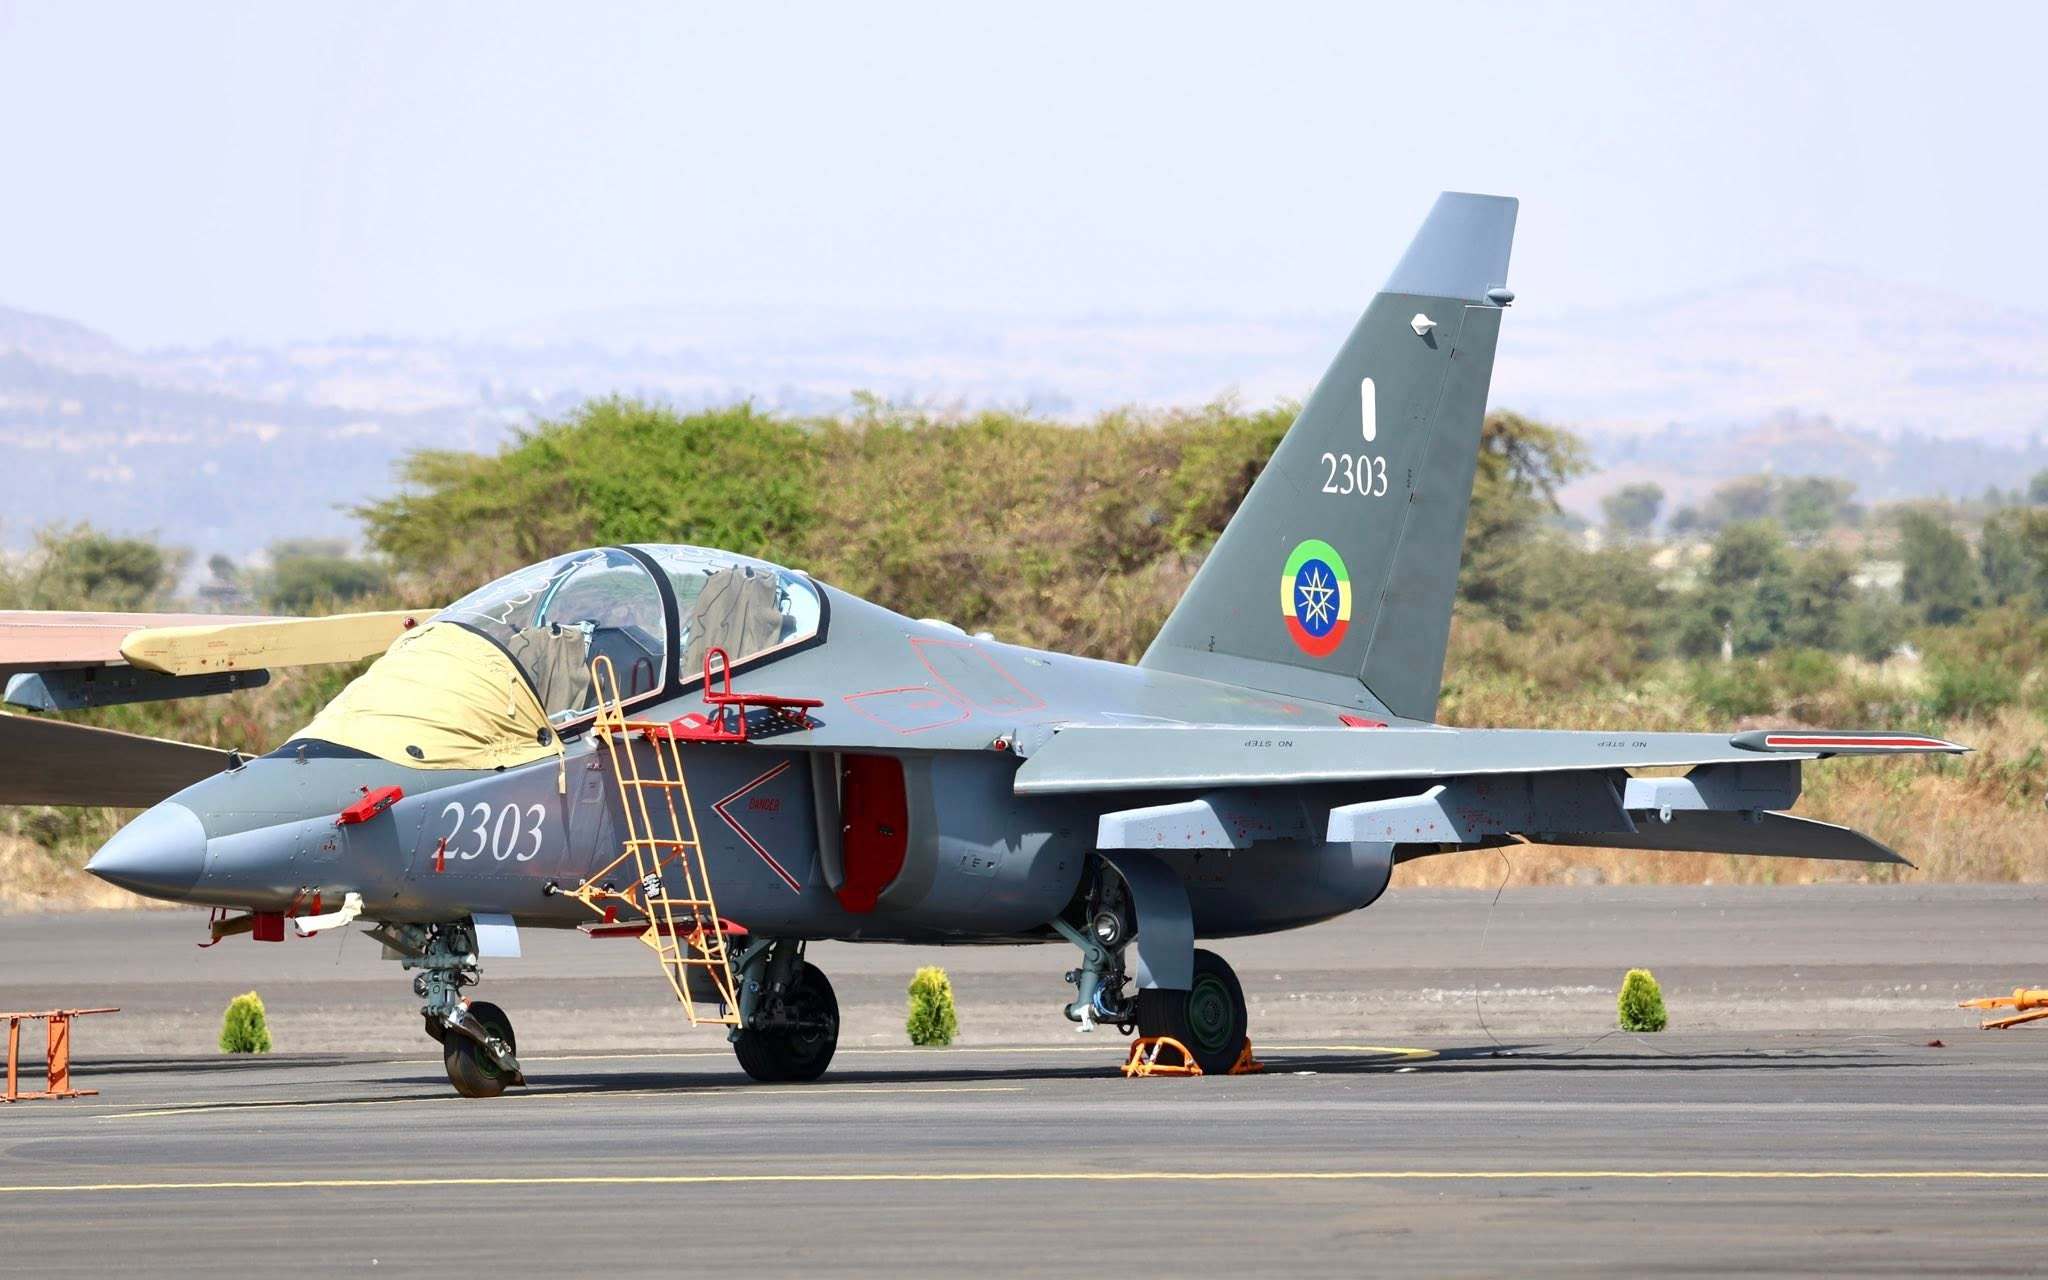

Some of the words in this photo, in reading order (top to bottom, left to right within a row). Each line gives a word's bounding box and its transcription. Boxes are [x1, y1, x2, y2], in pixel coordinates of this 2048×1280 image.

[1321, 452, 1388, 497] 2303
[748, 798, 780, 811] DANGER
[431, 802, 546, 861] 2303
